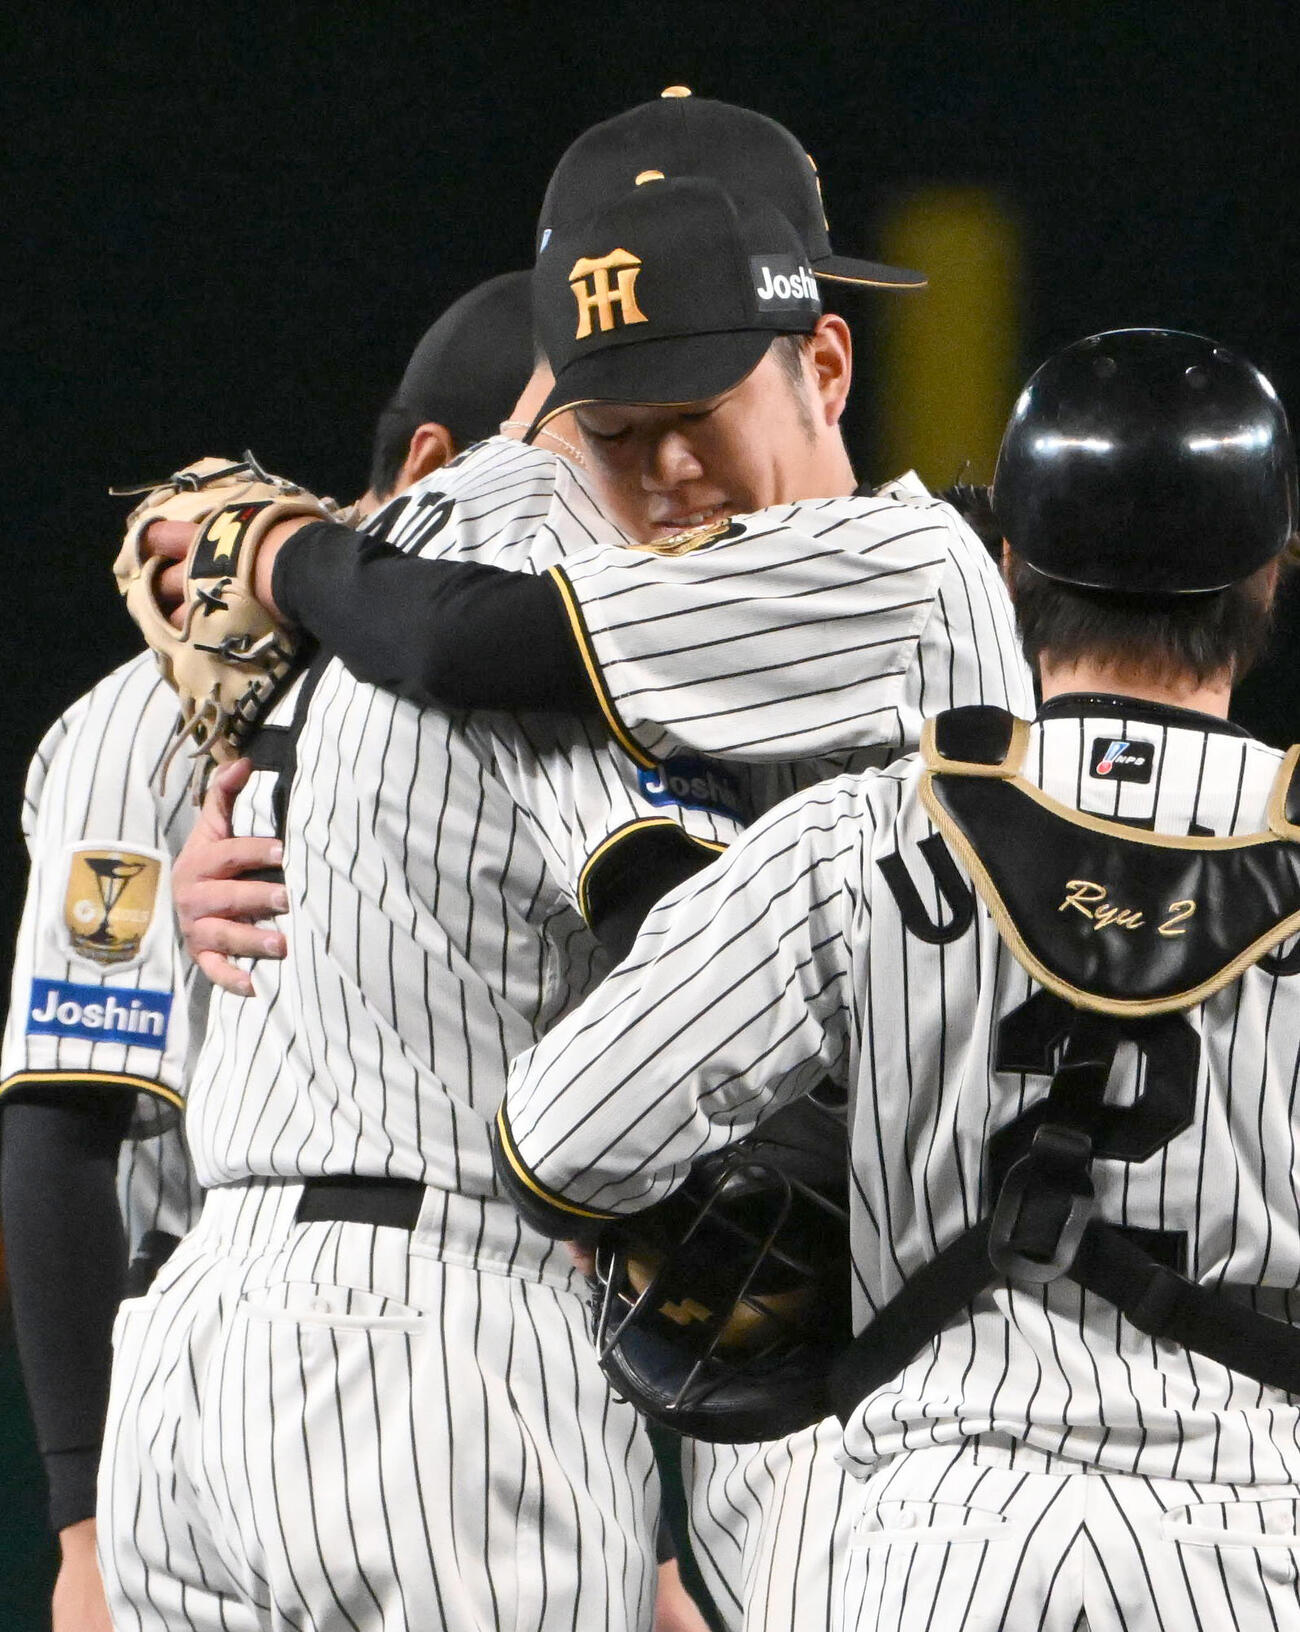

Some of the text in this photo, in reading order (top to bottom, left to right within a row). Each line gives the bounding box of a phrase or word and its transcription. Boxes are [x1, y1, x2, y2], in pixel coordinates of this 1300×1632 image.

[1058, 879, 1197, 936] Ryu 2
[31, 990, 165, 1037] Joshin
